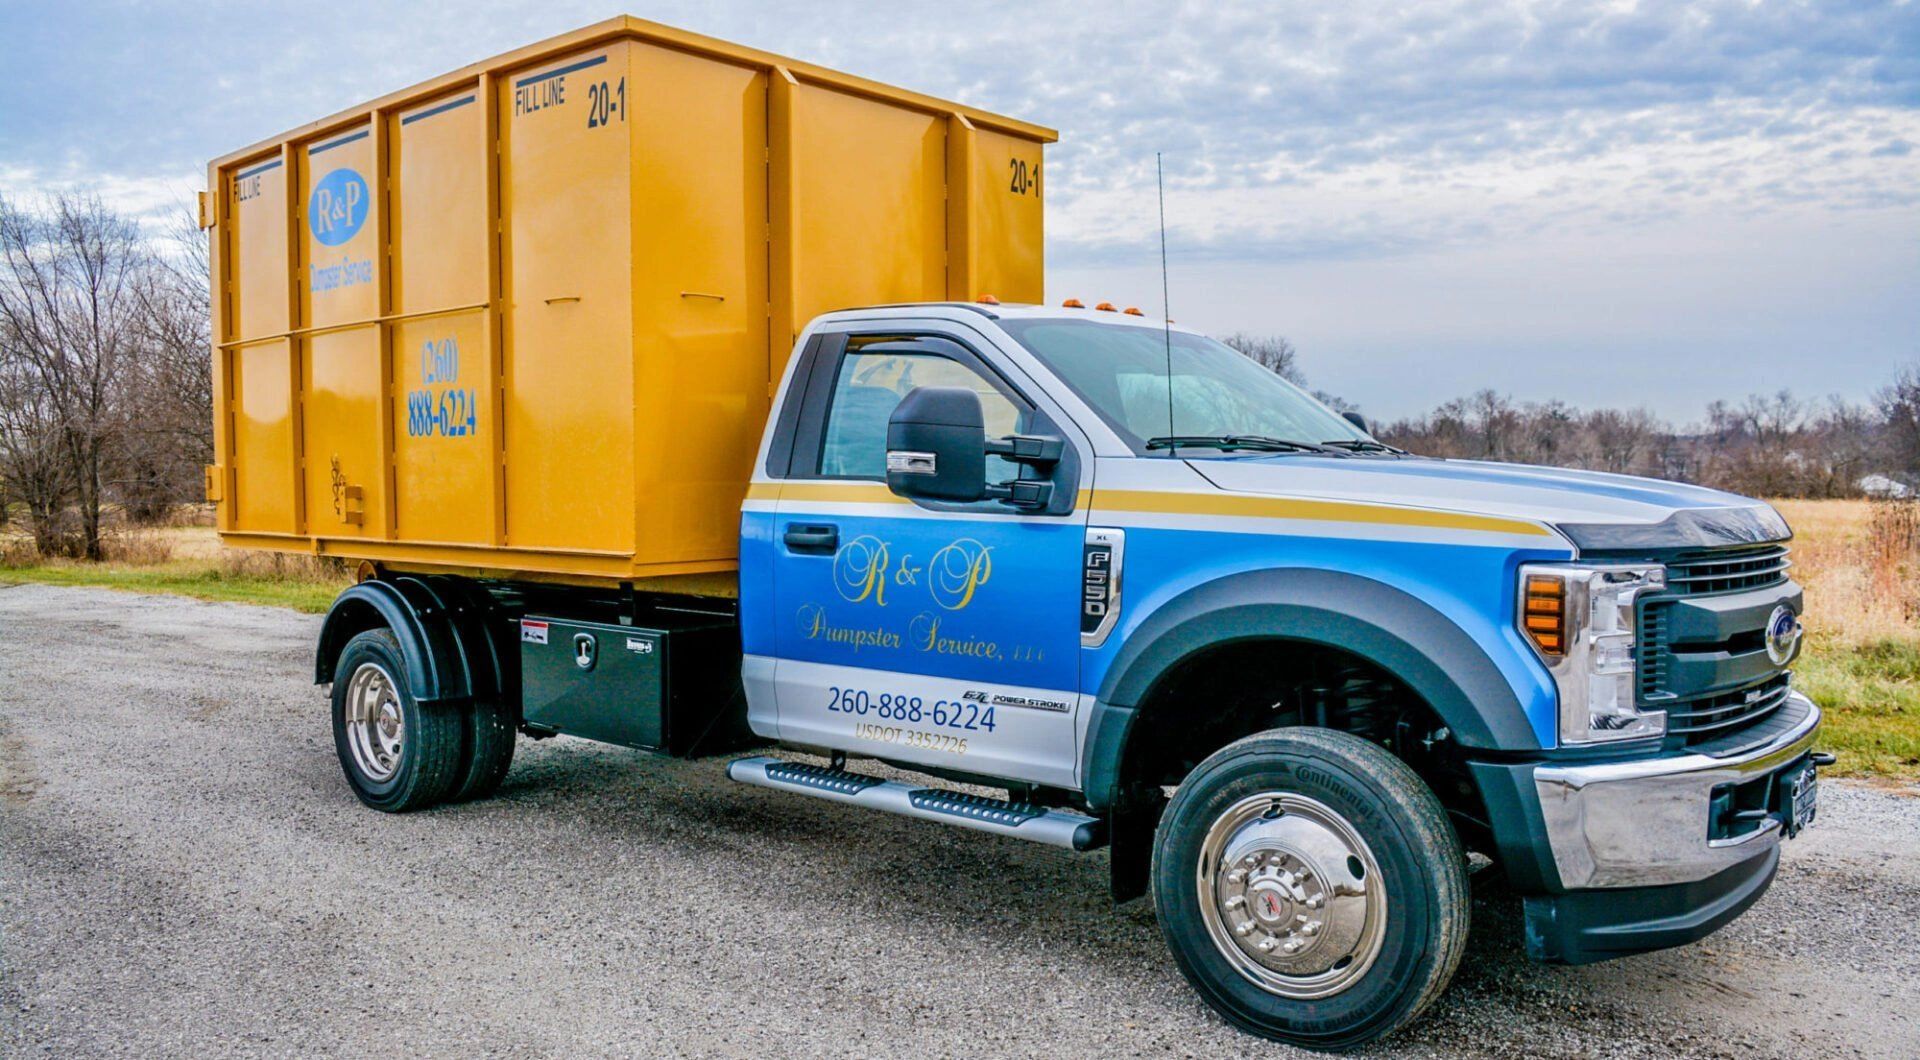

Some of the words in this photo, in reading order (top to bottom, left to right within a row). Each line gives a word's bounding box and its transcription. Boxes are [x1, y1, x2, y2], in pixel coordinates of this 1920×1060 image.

[516, 84, 541, 116] FILL
[543, 77, 565, 108] LINE
[588, 76, 625, 129] 20-1
[1010, 157, 1039, 198] 20-1
[317, 181, 361, 234] R&P
[342, 256, 372, 287] Service
[421, 336, 459, 385] (260)
[408, 389, 476, 436] 888-6224
[796, 601, 901, 653] Dumpster
[827, 686, 996, 733] 260-888-6224
[993, 694, 1026, 706] POWER
[1028, 698, 1067, 711] STROKE
[855, 722, 903, 742] USDOT
[904, 729, 968, 755] 3352726
[1295, 765, 1375, 820] Continental
